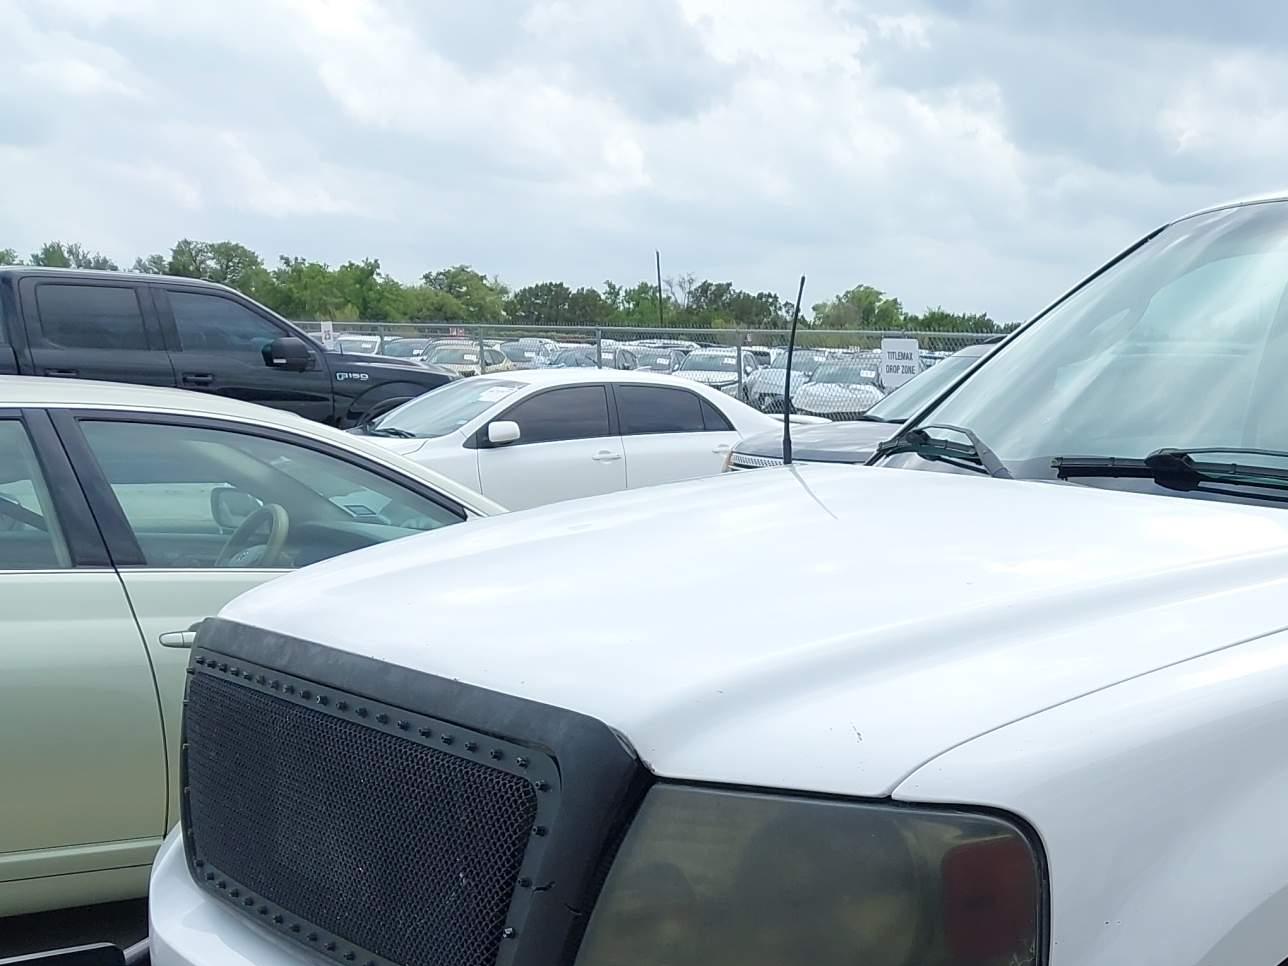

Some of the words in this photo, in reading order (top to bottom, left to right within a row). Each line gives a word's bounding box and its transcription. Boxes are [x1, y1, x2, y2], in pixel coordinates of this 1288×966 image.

[887, 351, 914, 361] TITLEMAX
[885, 364, 900, 374] DROP
[901, 365, 916, 375] ZONE
